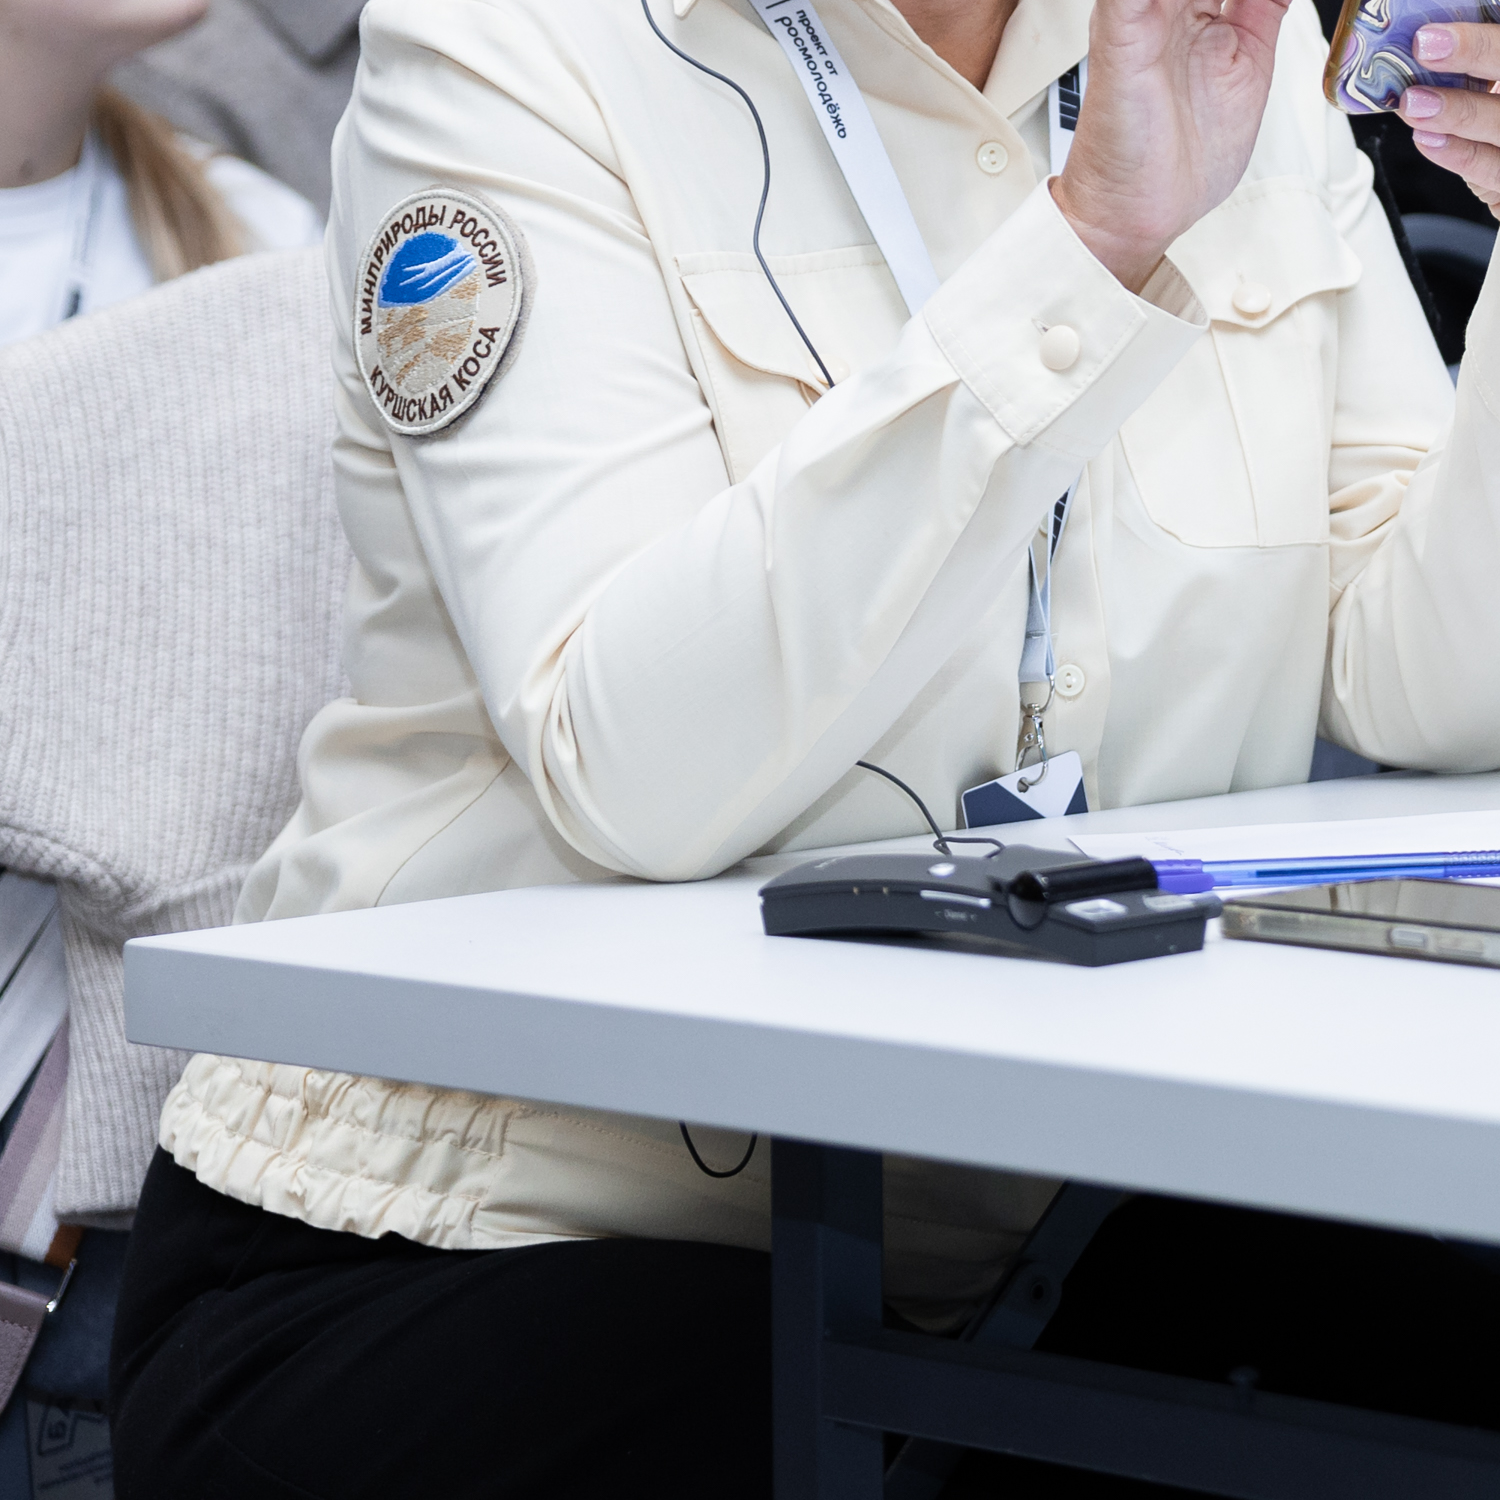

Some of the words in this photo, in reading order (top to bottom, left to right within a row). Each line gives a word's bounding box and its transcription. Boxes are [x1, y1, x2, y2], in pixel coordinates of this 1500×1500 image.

[774, 15, 847, 140] росмолодёжь
[796, 8, 827, 58] проект
[824, 55, 838, 76] от
[361, 204, 447, 335] МИНПРИРОДЫ
[449, 208, 507, 288] РОССИИ
[369, 365, 455, 422] КУРШСКАЯ
[453, 326, 501, 391] КОСА
